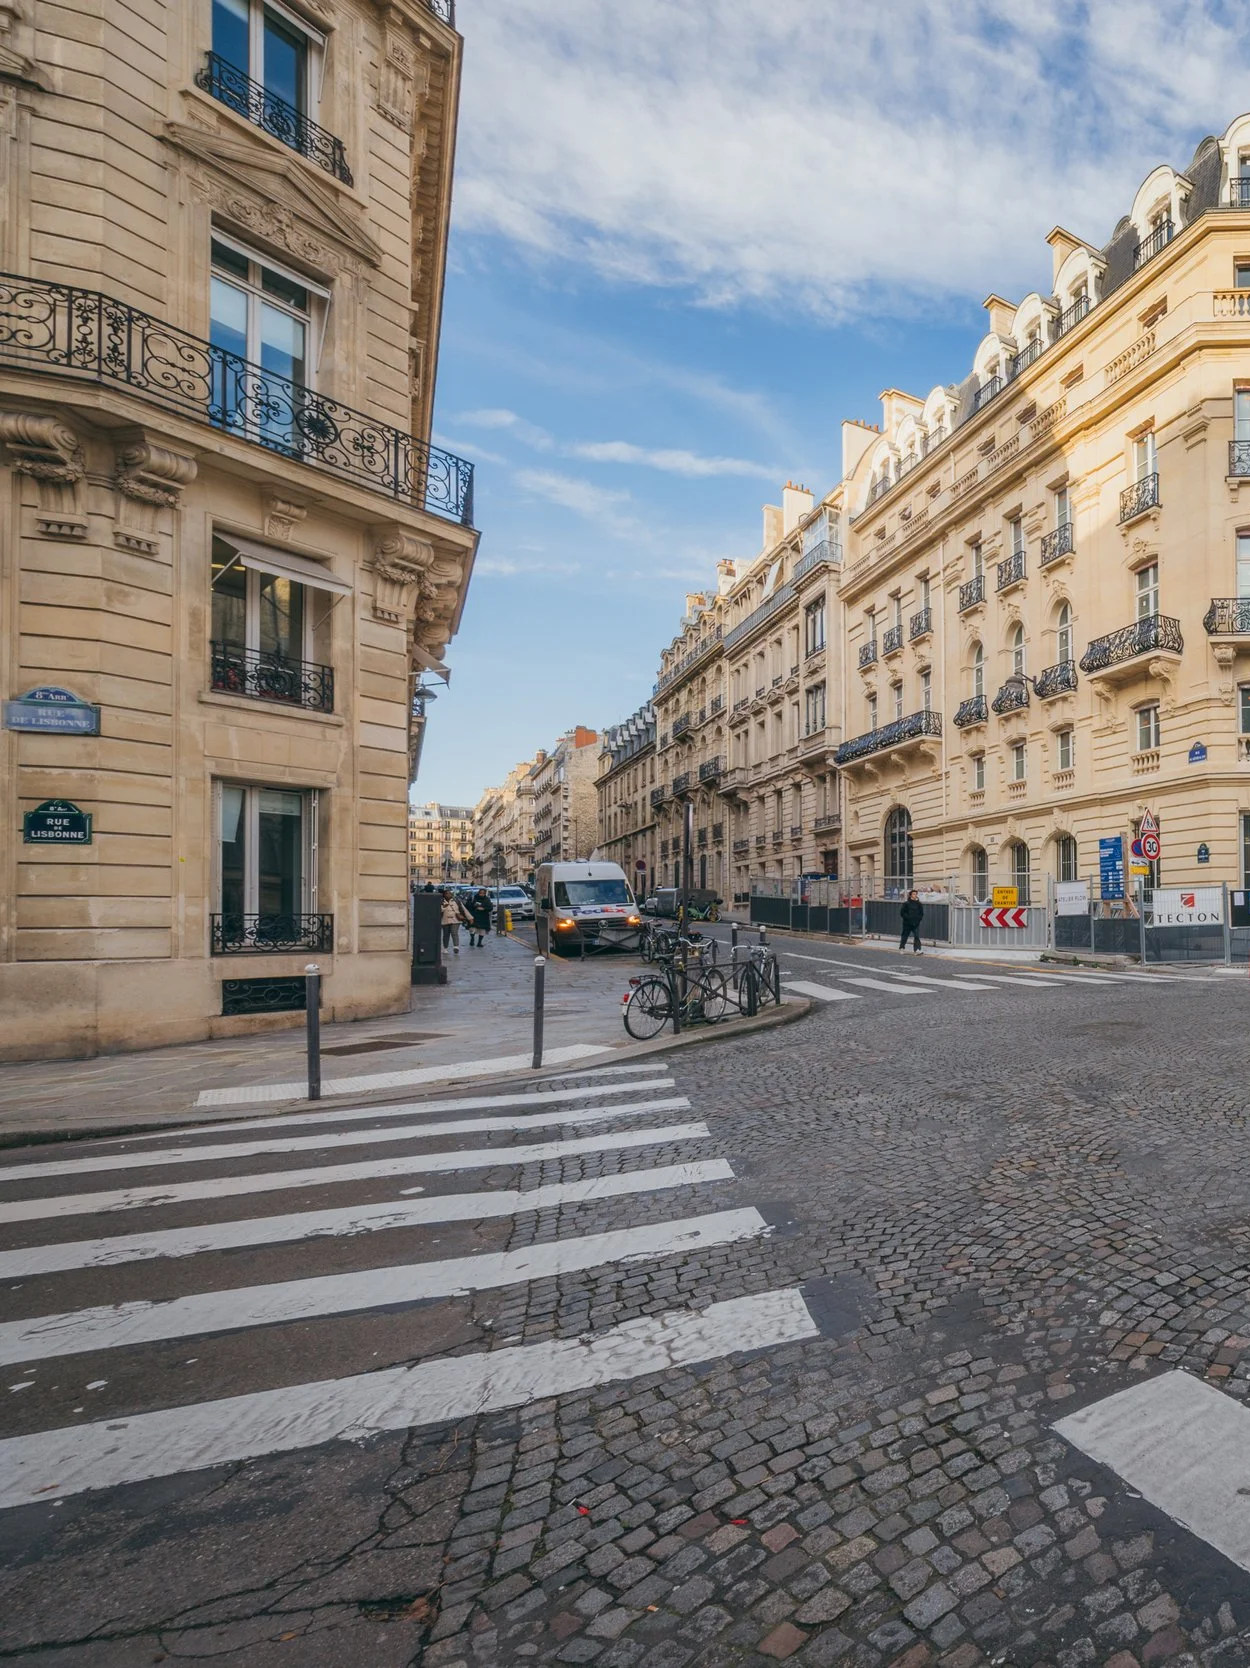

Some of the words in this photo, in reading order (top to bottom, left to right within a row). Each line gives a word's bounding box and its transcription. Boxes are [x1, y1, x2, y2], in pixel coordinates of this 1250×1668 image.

[37, 708, 65, 718] RUE
[11, 716, 28, 724] DE
[31, 718, 90, 728] LISBONNE
[46, 818, 70, 826] RUE
[31, 830, 85, 839] LISBONNE
[1146, 841, 1158, 853] 30
[571, 905, 627, 917] FedEx
[1157, 912, 1220, 924] TECTON
